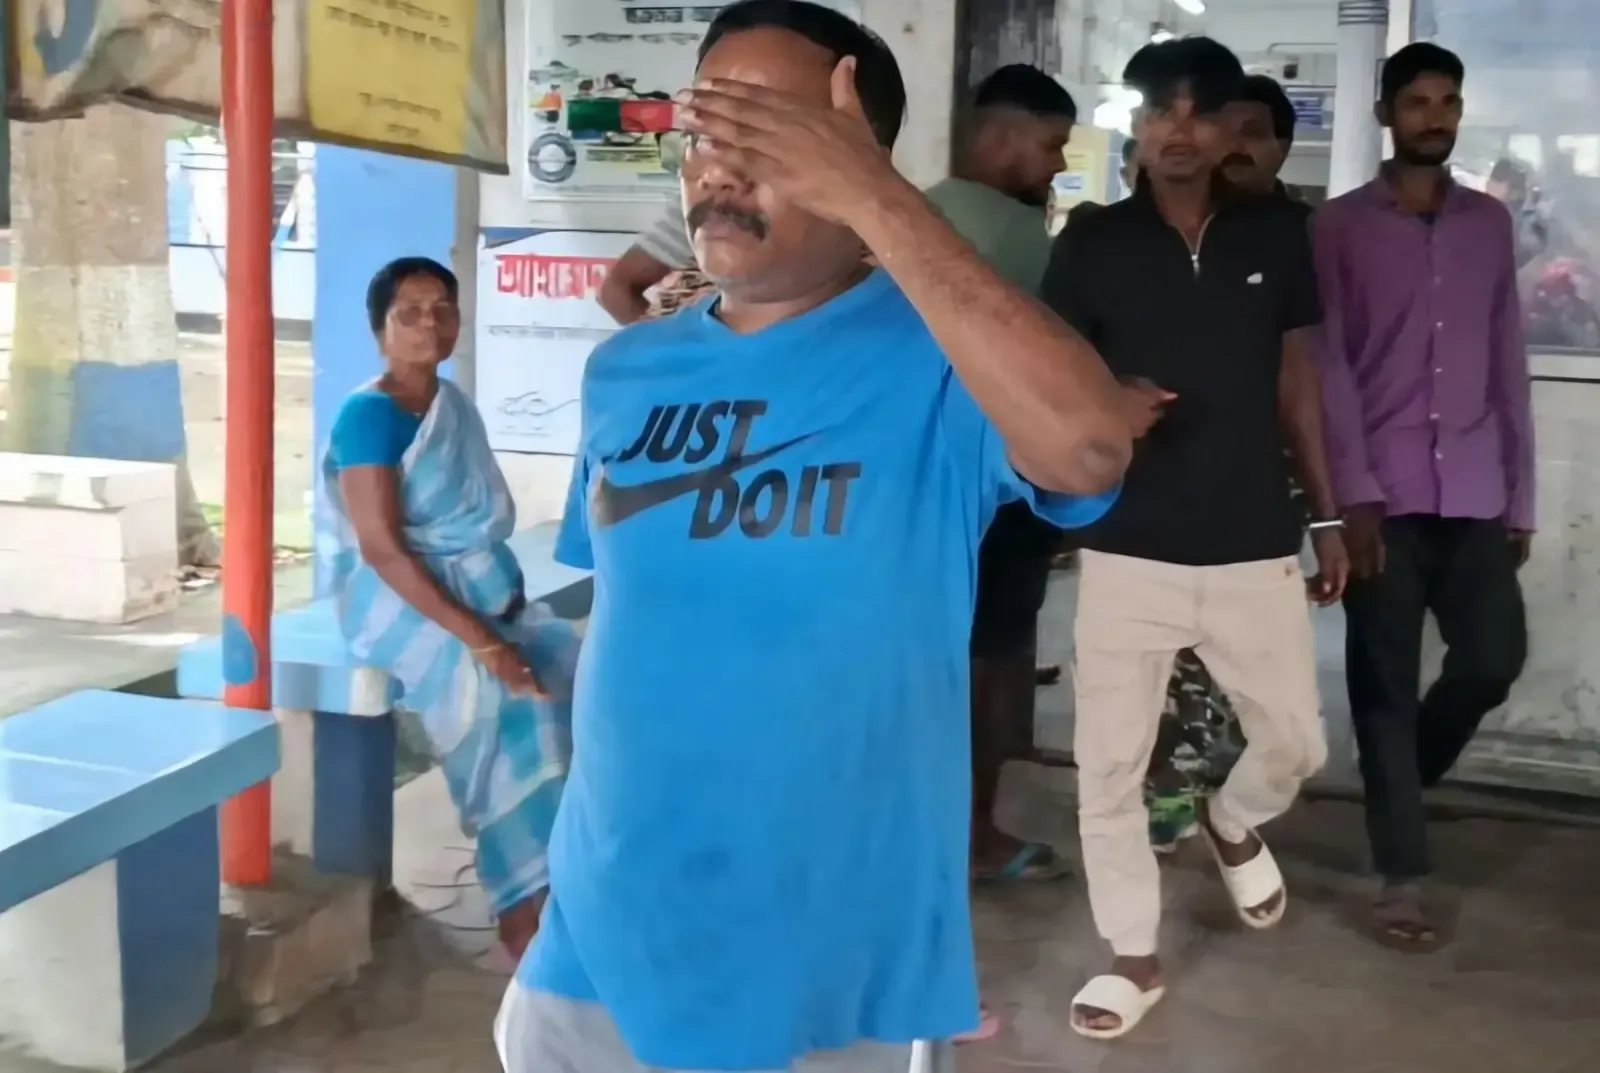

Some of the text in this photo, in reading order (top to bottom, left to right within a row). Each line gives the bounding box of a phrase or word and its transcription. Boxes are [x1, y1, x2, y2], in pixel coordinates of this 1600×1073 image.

[616, 400, 768, 467] JUST
[688, 462, 861, 539] DO IT
